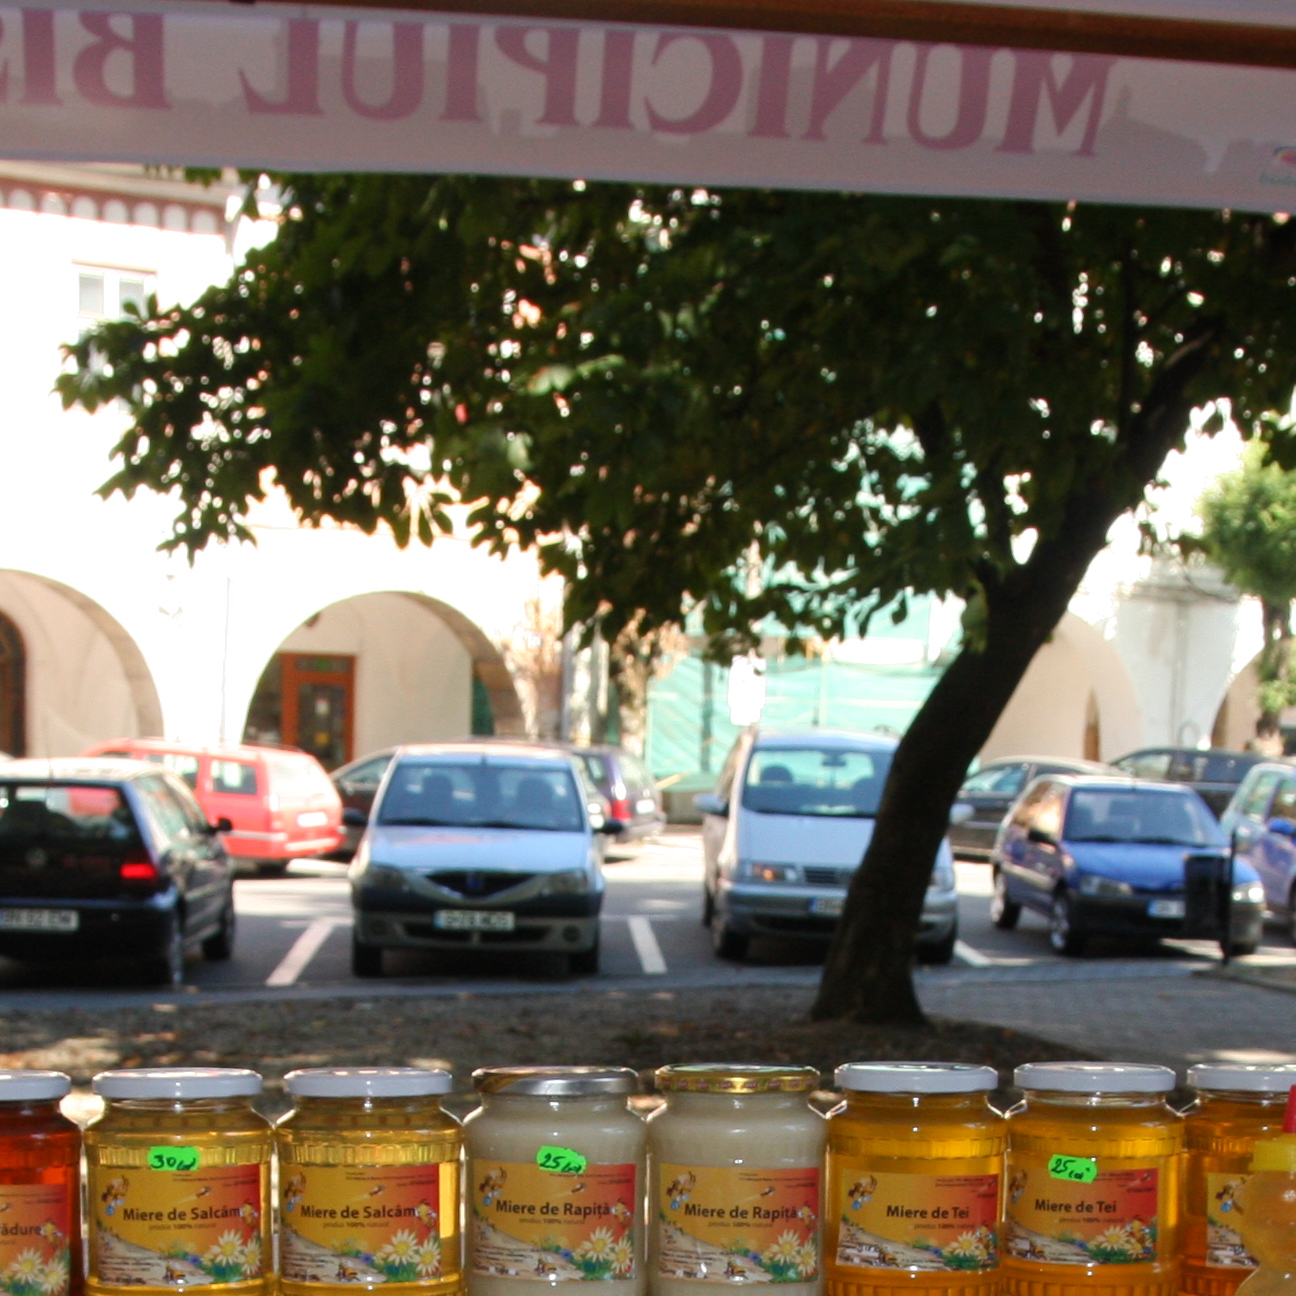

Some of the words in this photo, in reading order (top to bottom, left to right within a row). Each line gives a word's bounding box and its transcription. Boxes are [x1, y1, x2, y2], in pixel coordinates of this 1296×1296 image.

[151, 1155, 176, 1169] 30
[540, 1153, 566, 1168] 25
[1051, 1158, 1076, 1173] 25
[123, 1207, 163, 1221] Miere
[168, 1207, 186, 1221] de
[191, 1205, 240, 1220] Salcâm
[301, 1205, 339, 1218] Miere
[341, 1205, 359, 1218] de
[364, 1204, 415, 1218] Salcâm
[496, 1200, 535, 1215] Miere
[540, 1202, 559, 1215] de
[685, 1204, 725, 1218] Miere
[730, 1206, 748, 1219] de
[887, 1205, 928, 1219] Miere
[932, 1206, 949, 1219] de
[952, 1206, 969, 1218] Tei
[1035, 1199, 1072, 1213] Miere
[1076, 1200, 1094, 1213] de
[1096, 1200, 1117, 1213] Tei
